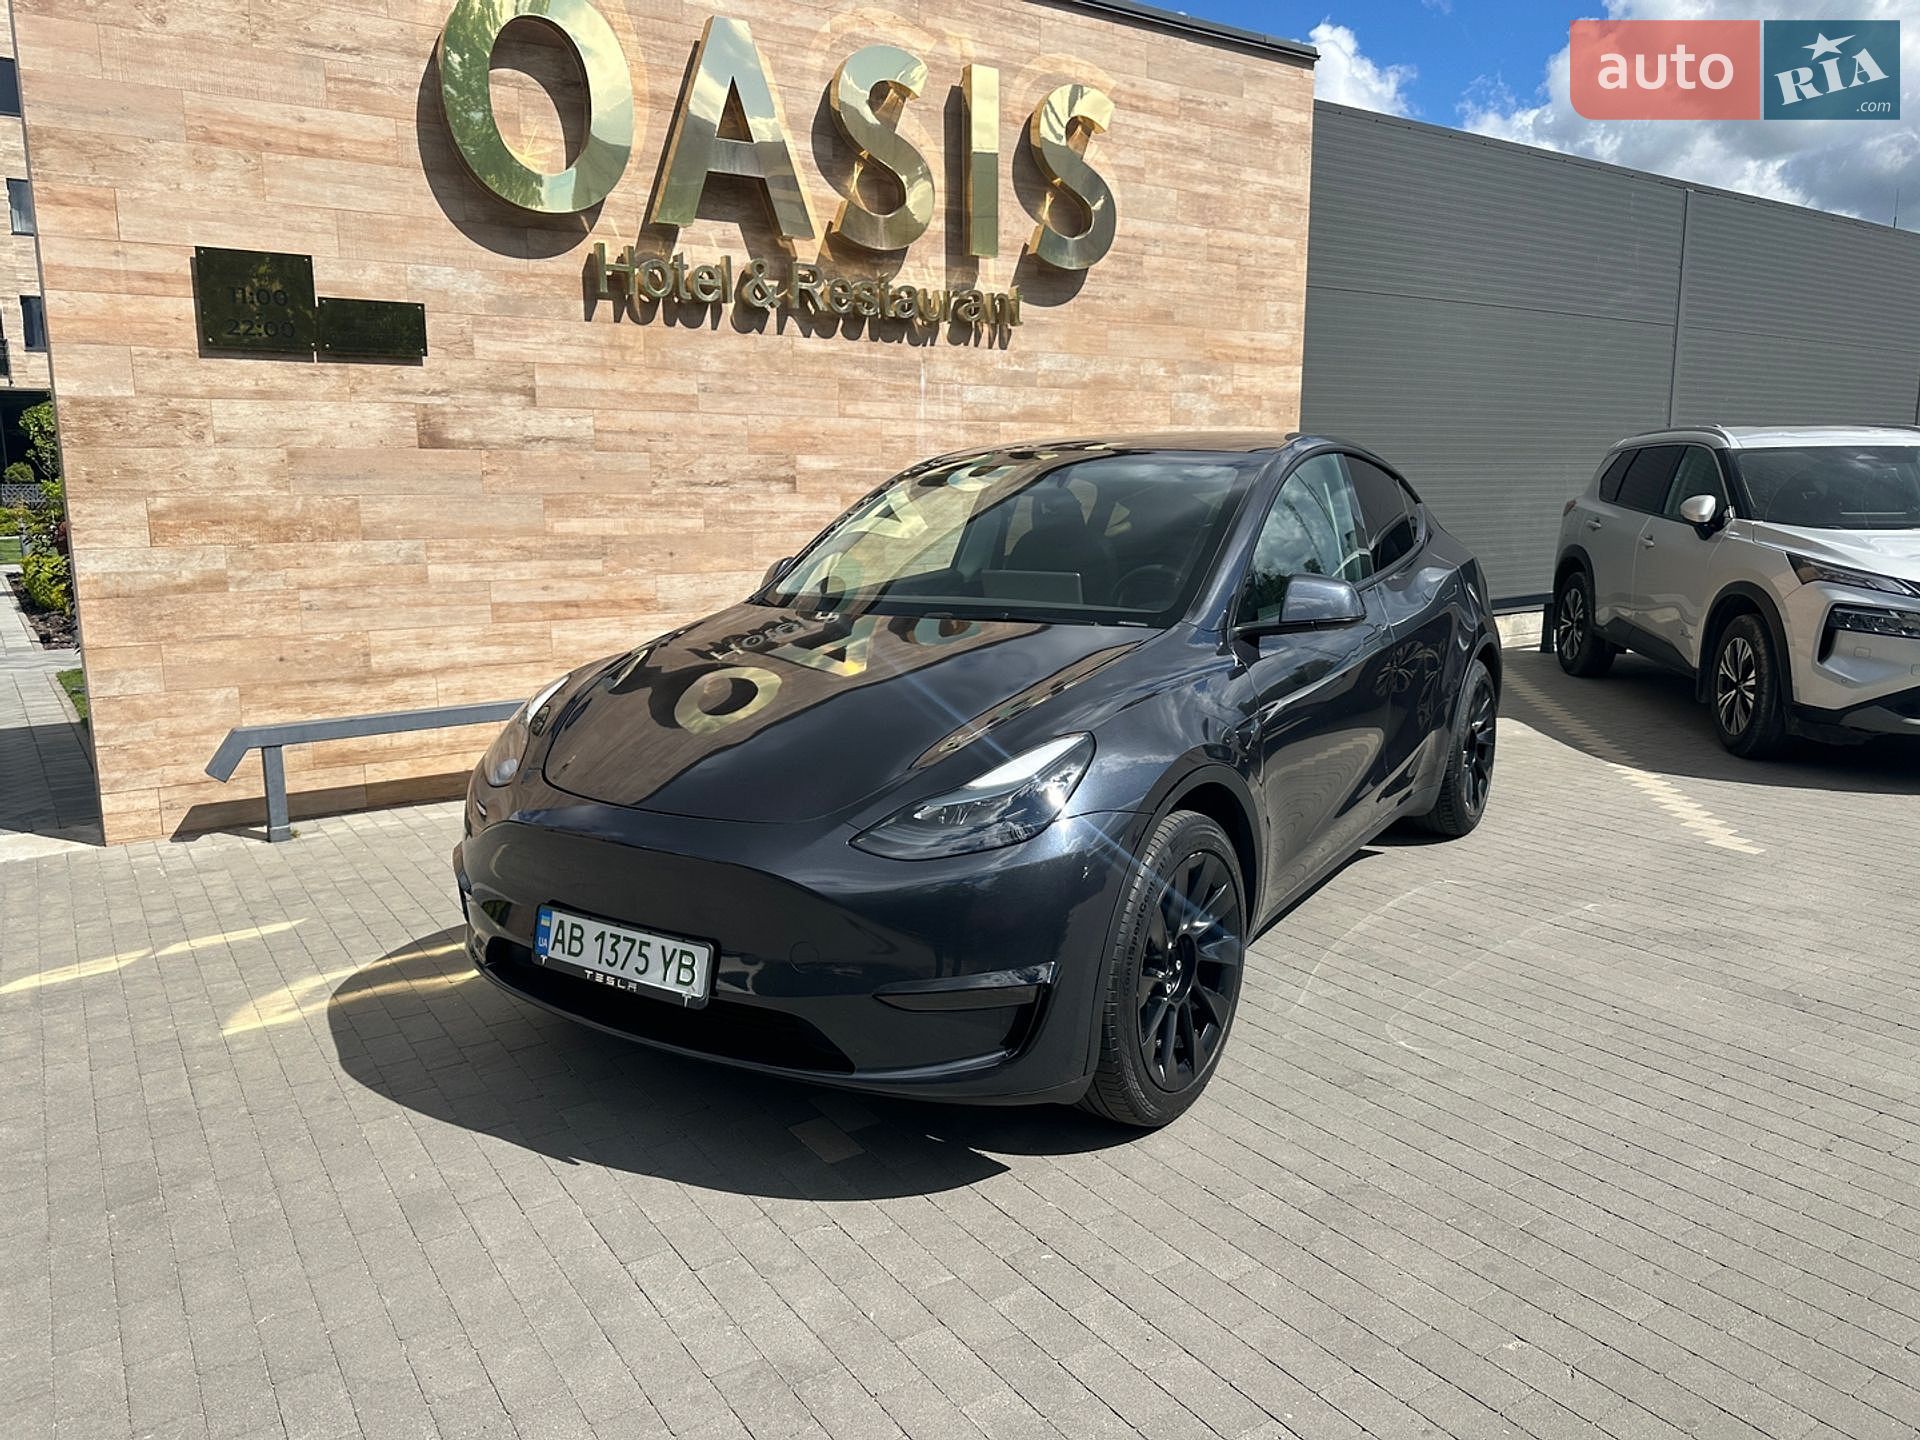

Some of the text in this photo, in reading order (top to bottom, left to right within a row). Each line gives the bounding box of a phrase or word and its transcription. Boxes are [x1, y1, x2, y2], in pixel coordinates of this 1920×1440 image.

[438, 0, 1118, 271] OASIS
[228, 286, 289, 307] 11:00
[593, 242, 1023, 328] Hotel & Restaurant
[226, 317, 296, 339] 22:00
[537, 936, 549, 949] UA
[551, 919, 697, 988] AB 1375 YB
[584, 969, 639, 993] TESLA
